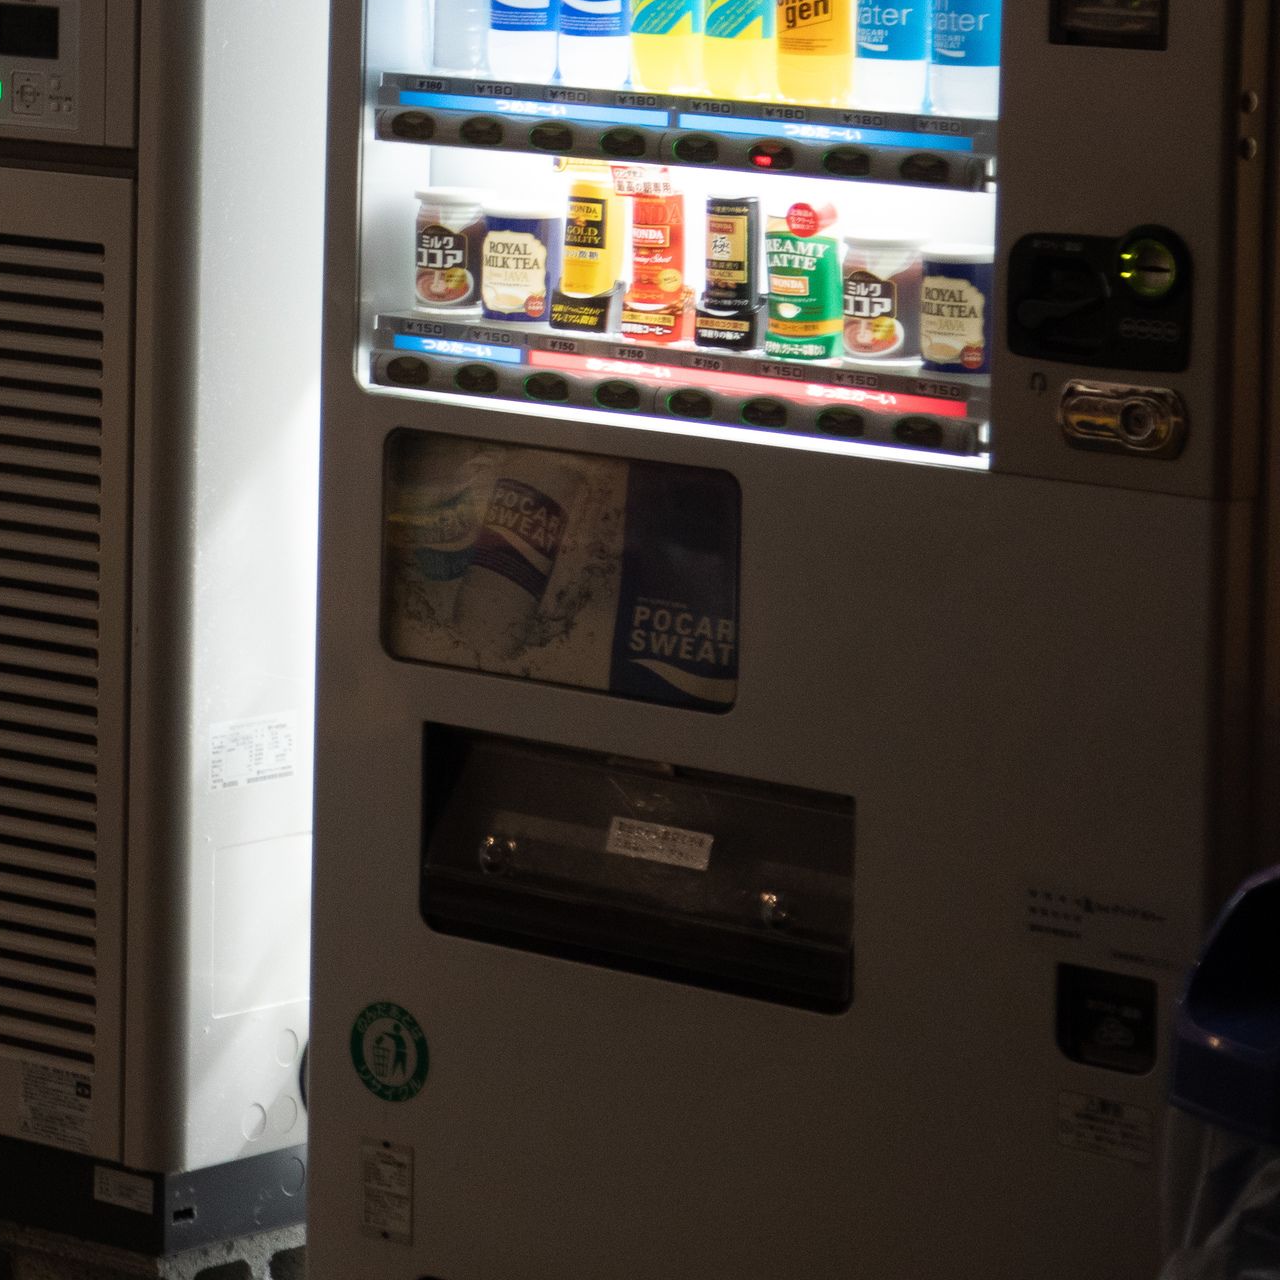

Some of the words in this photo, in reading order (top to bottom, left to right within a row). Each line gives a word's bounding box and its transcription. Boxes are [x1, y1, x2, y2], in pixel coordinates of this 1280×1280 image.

[476, 83, 514, 96] ¥180
[548, 89, 587, 103] ¥180
[616, 94, 657, 107] ¥180
[691, 100, 732, 114] ¥180
[764, 107, 806, 120] ¥180
[421, 234, 454, 250] ミルク
[489, 240, 532, 256] ROYAL
[416, 249, 464, 269] ココア
[514, 256, 541, 271] TEA
[846, 281, 883, 297] ミルク
[924, 286, 969, 304] ROYAL
[843, 294, 892, 318] ココア
[949, 305, 979, 319] TEA
[628, 628, 735, 667] SWEAT
